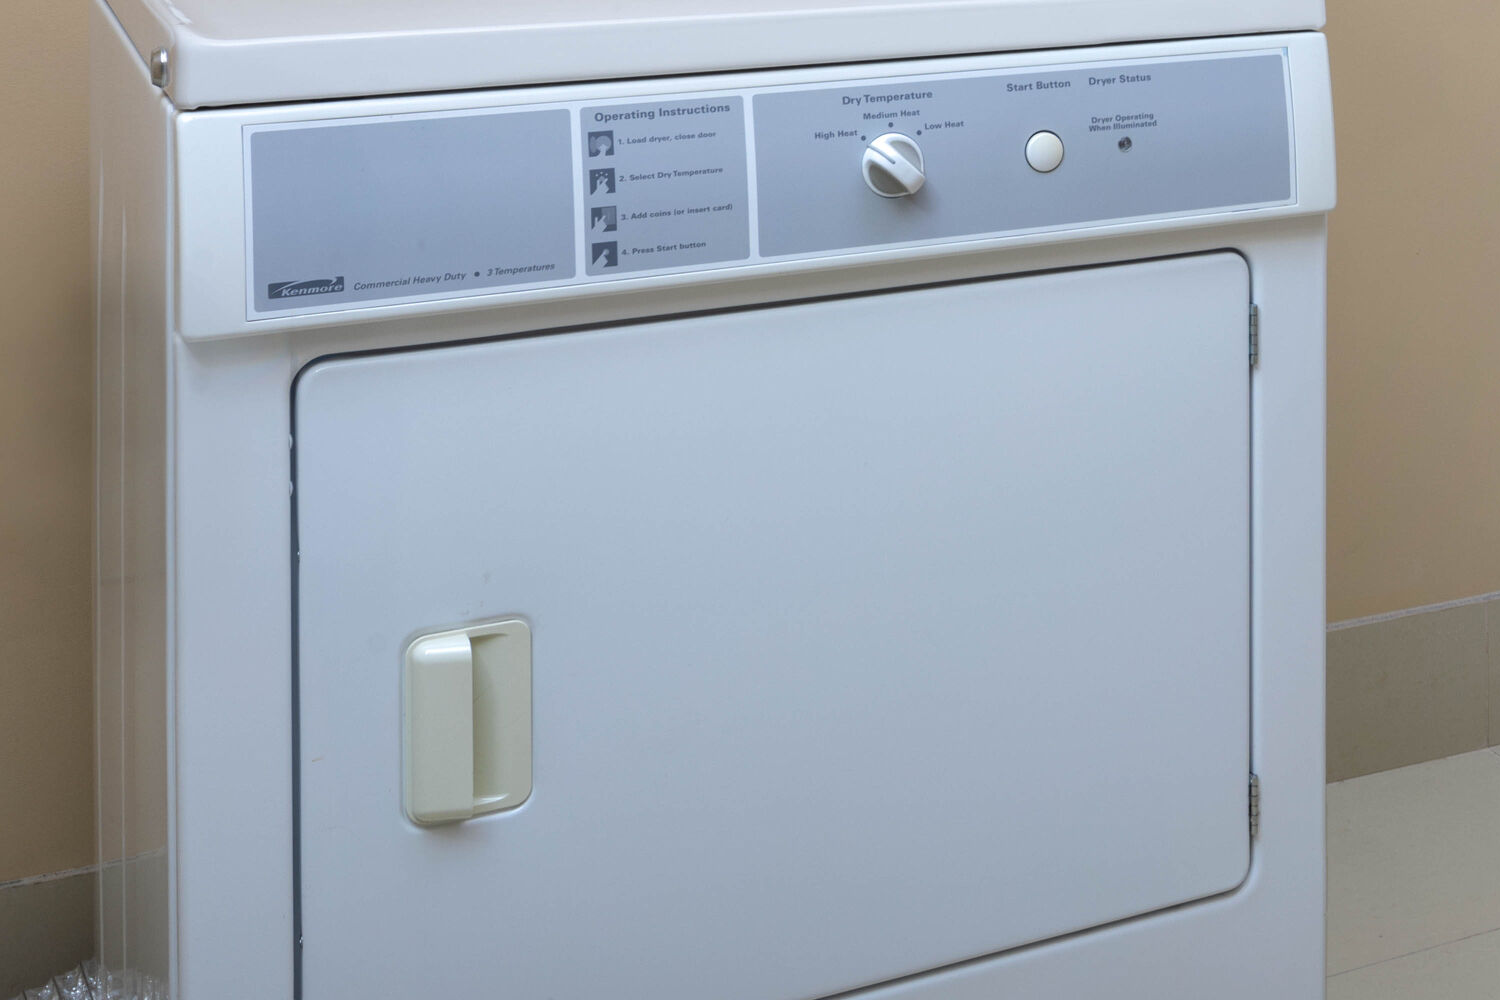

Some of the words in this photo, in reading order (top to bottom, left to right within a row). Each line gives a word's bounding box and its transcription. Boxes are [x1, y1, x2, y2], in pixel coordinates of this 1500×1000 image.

[1006, 83, 1033, 92] Start
[1036, 80, 1071, 90] Button
[1088, 77, 1116, 87] Dryer
[1119, 74, 1152, 84] Status
[842, 96, 861, 106] Dry
[863, 91, 933, 103] Temperature
[594, 109, 655, 123] Operating
[659, 103, 731, 117] Instructions
[863, 111, 898, 120] Medium
[900, 109, 921, 117] Heat
[1091, 116, 1113, 125] Dryer
[1115, 112, 1154, 122] Operating
[944, 120, 965, 128] Heat
[1088, 124, 1111, 132] When
[1113, 120, 1158, 130] Illuminated
[627, 136, 647, 144] Load
[649, 135, 673, 143] dryer,
[674, 133, 696, 141] close
[814, 131, 835, 140] High
[838, 130, 858, 138] Heat
[629, 173, 655, 181] Select
[657, 171, 672, 179] Dry
[672, 167, 724, 177] Temperature
[631, 212, 648, 220] Add
[649, 210, 671, 218] coins
[673, 208, 685, 217] (or
[687, 206, 711, 214] insert
[712, 203, 733, 211] card)
[632, 247, 655, 255] Press
[656, 244, 678, 252] Start
[679, 241, 707, 250] button
[353, 275, 411, 291] Commercial
[413, 275, 442, 285] Heavy
[444, 272, 467, 281] Duty
[487, 269, 493, 277] 3
[495, 263, 556, 276] Temperatures
[281, 284, 342, 296] Kenmore
